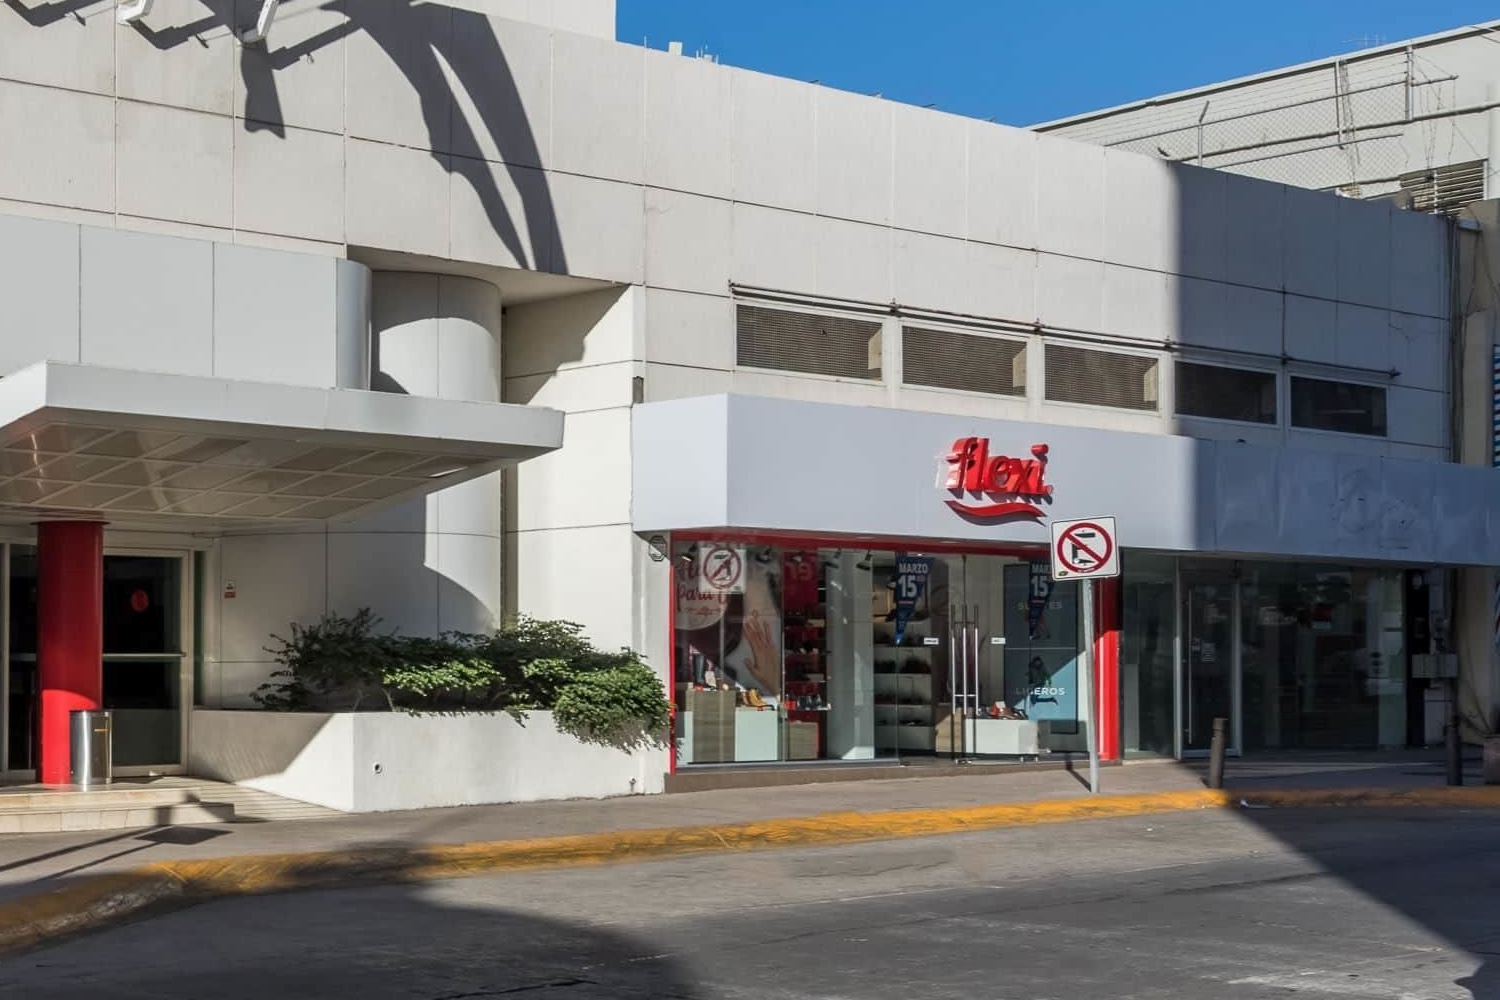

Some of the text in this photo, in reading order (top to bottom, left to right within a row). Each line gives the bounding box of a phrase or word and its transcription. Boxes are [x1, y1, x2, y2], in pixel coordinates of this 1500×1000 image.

[946, 436, 1053, 495] flexi
[898, 562, 929, 574] MARZO
[897, 575, 917, 598] 15
[1031, 575, 1049, 598] 15
